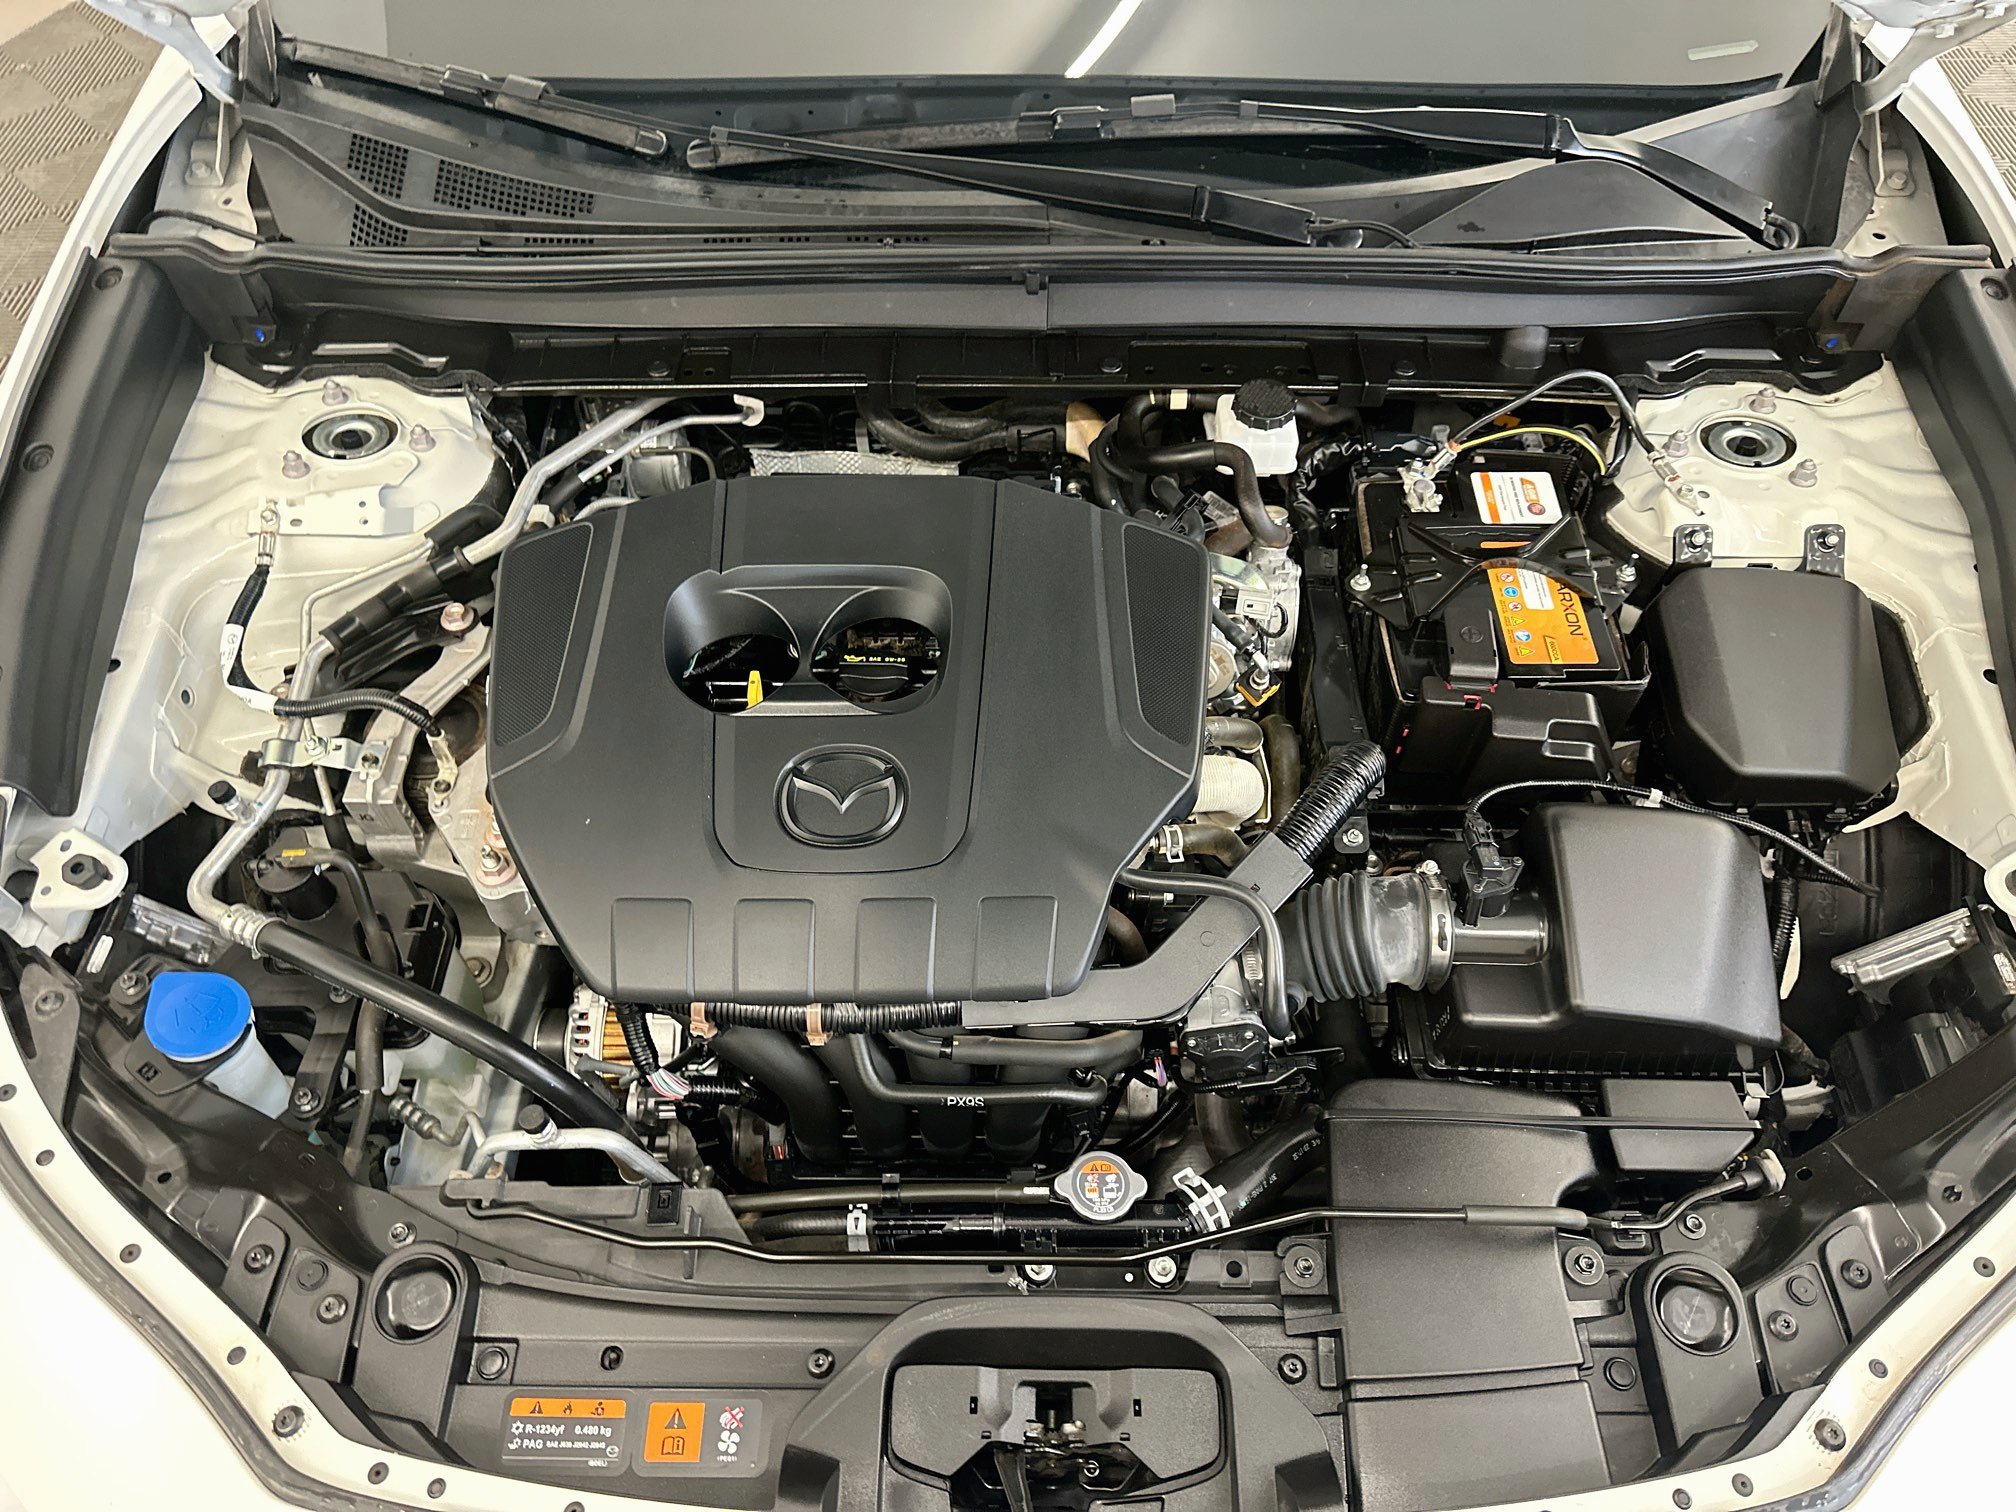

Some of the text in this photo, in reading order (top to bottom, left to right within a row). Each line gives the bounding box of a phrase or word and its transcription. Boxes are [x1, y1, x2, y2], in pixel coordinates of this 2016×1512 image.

[1555, 582, 1585, 637] ARXON
[525, 1423, 612, 1438] R-1234yf 0.480 kg
[522, 1438, 544, 1449] PAG
